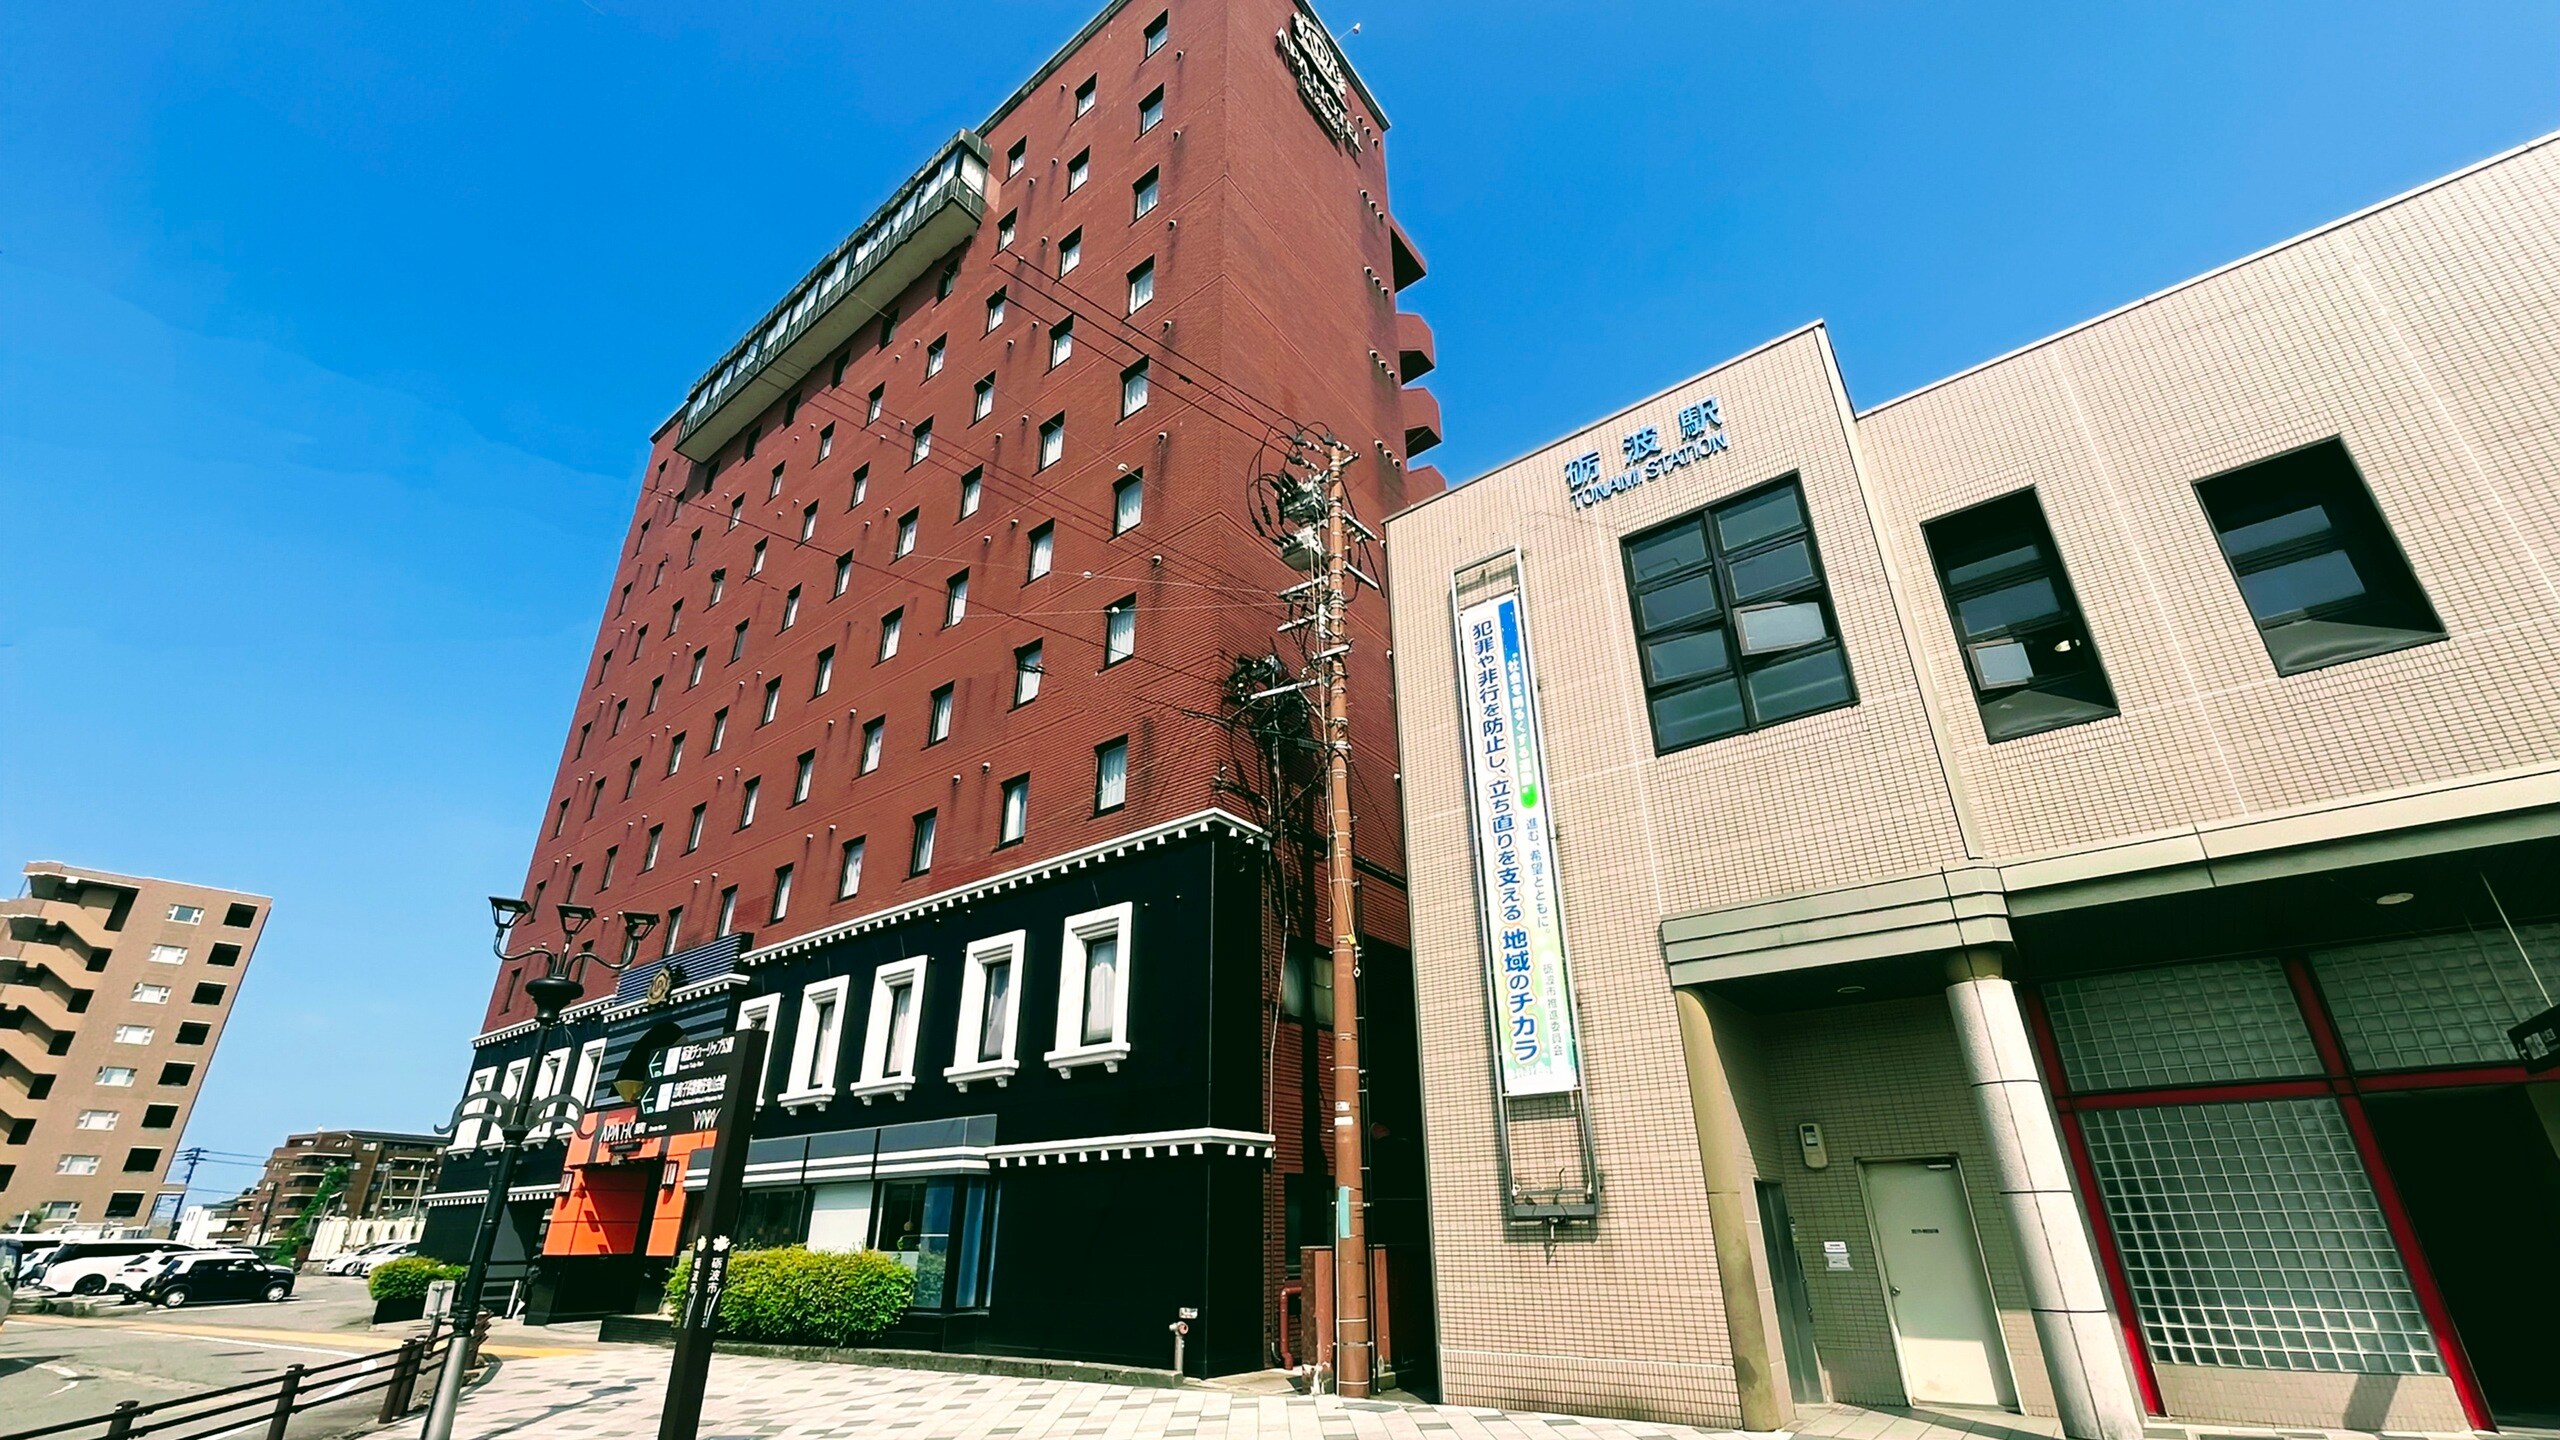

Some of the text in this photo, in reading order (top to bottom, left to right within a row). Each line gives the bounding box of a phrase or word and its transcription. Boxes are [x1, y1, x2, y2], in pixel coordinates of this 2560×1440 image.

[1275, 27, 1311, 81] APA
[1312, 73, 1363, 152] HOTEL
[1566, 394, 1722, 488] 砺波駅
[1571, 433, 1728, 509] TONAMI STATION
[1472, 620, 1523, 921] 犯罪や非行を防止し、立ち直りを支える
[1502, 928, 1538, 1061] 地域のチカラ
